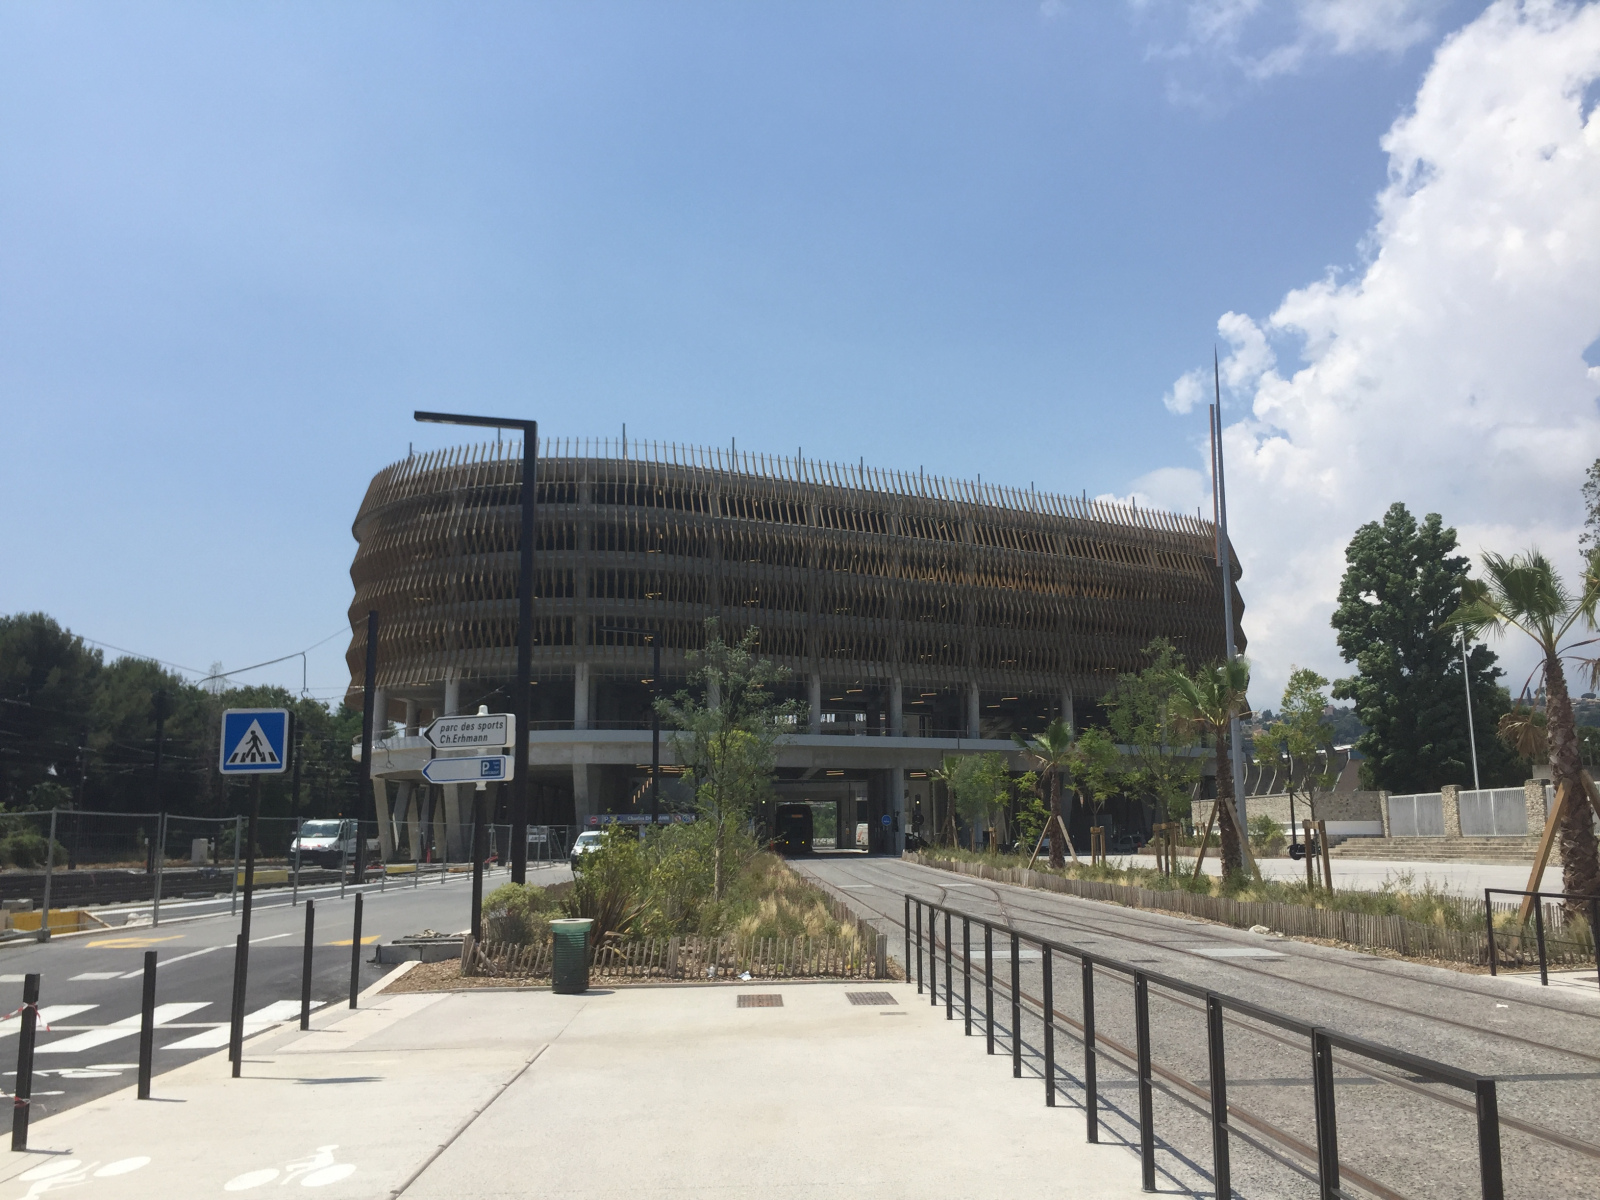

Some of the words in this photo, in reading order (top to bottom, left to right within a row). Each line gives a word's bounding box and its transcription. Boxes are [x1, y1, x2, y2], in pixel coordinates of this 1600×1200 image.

[440, 724, 458, 734] parc
[460, 722, 475, 730] des
[478, 721, 504, 732] sports
[440, 733, 488, 744] Ch.Erhmann
